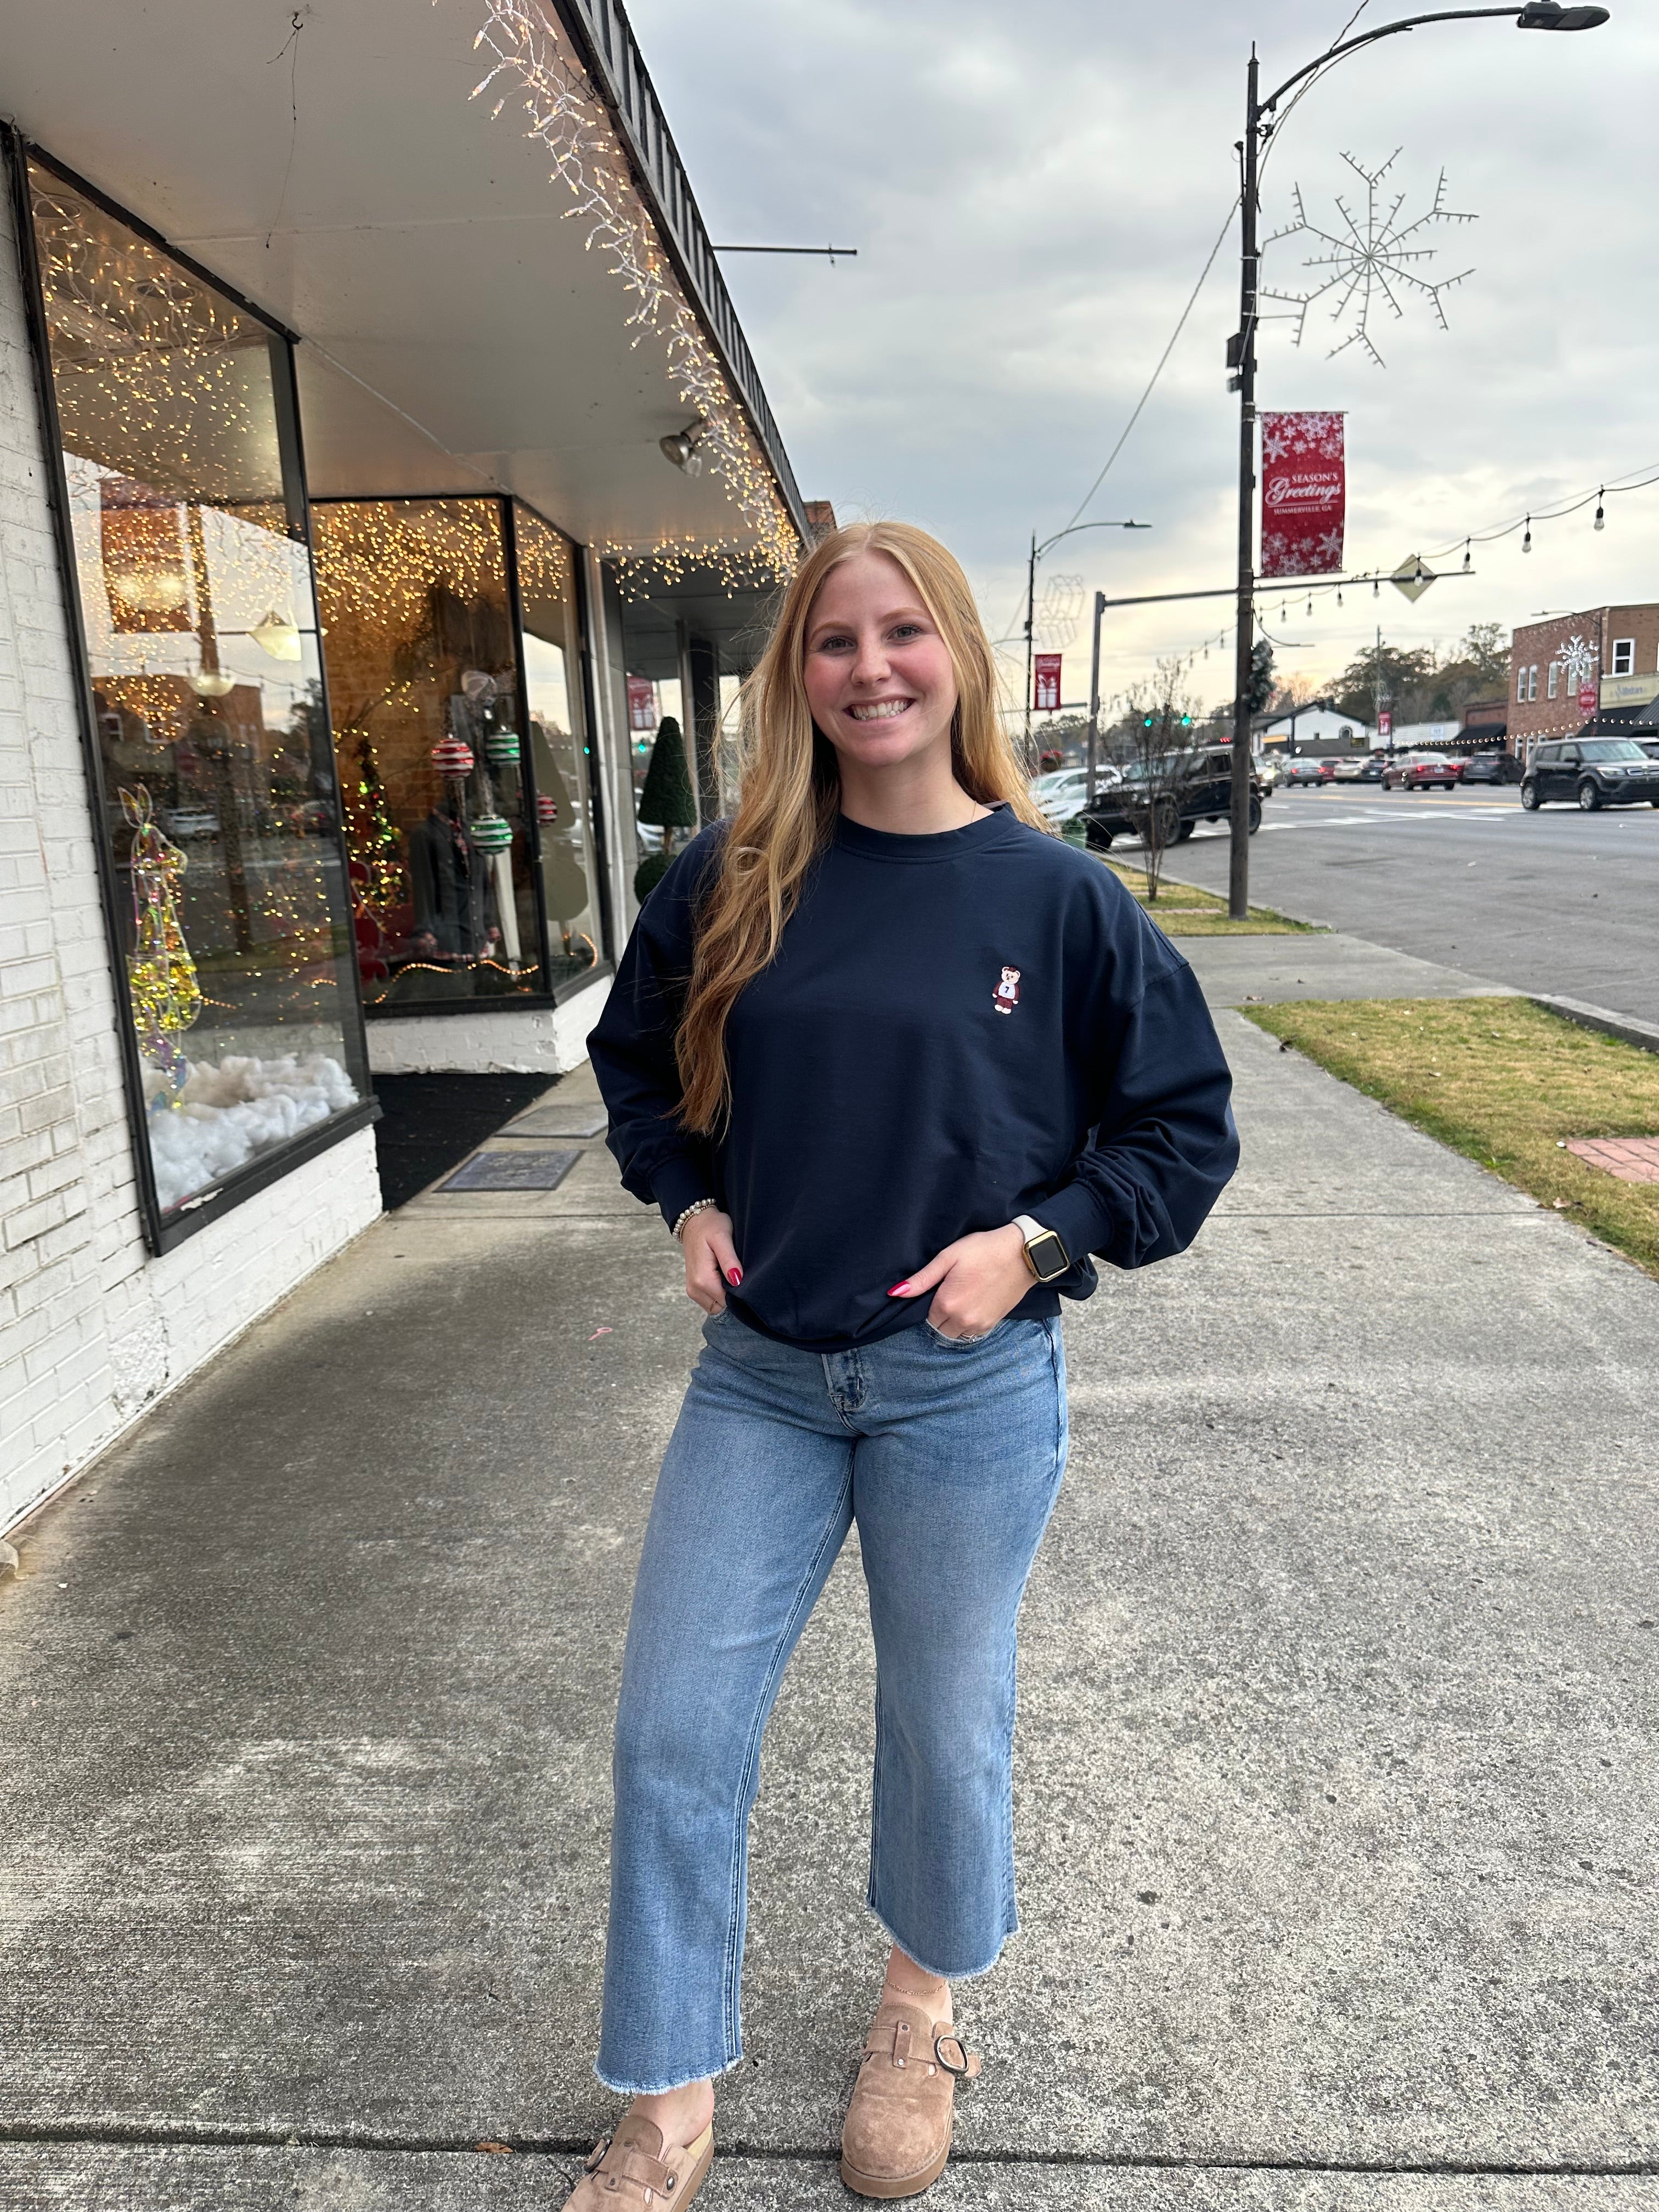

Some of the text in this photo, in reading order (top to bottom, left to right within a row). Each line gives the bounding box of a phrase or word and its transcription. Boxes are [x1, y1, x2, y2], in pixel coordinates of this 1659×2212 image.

[1292, 472, 1338, 483] SEASON'S
[1265, 476, 1342, 505] Greetings
[1274, 505, 1319, 515] SUMMERVILLE
